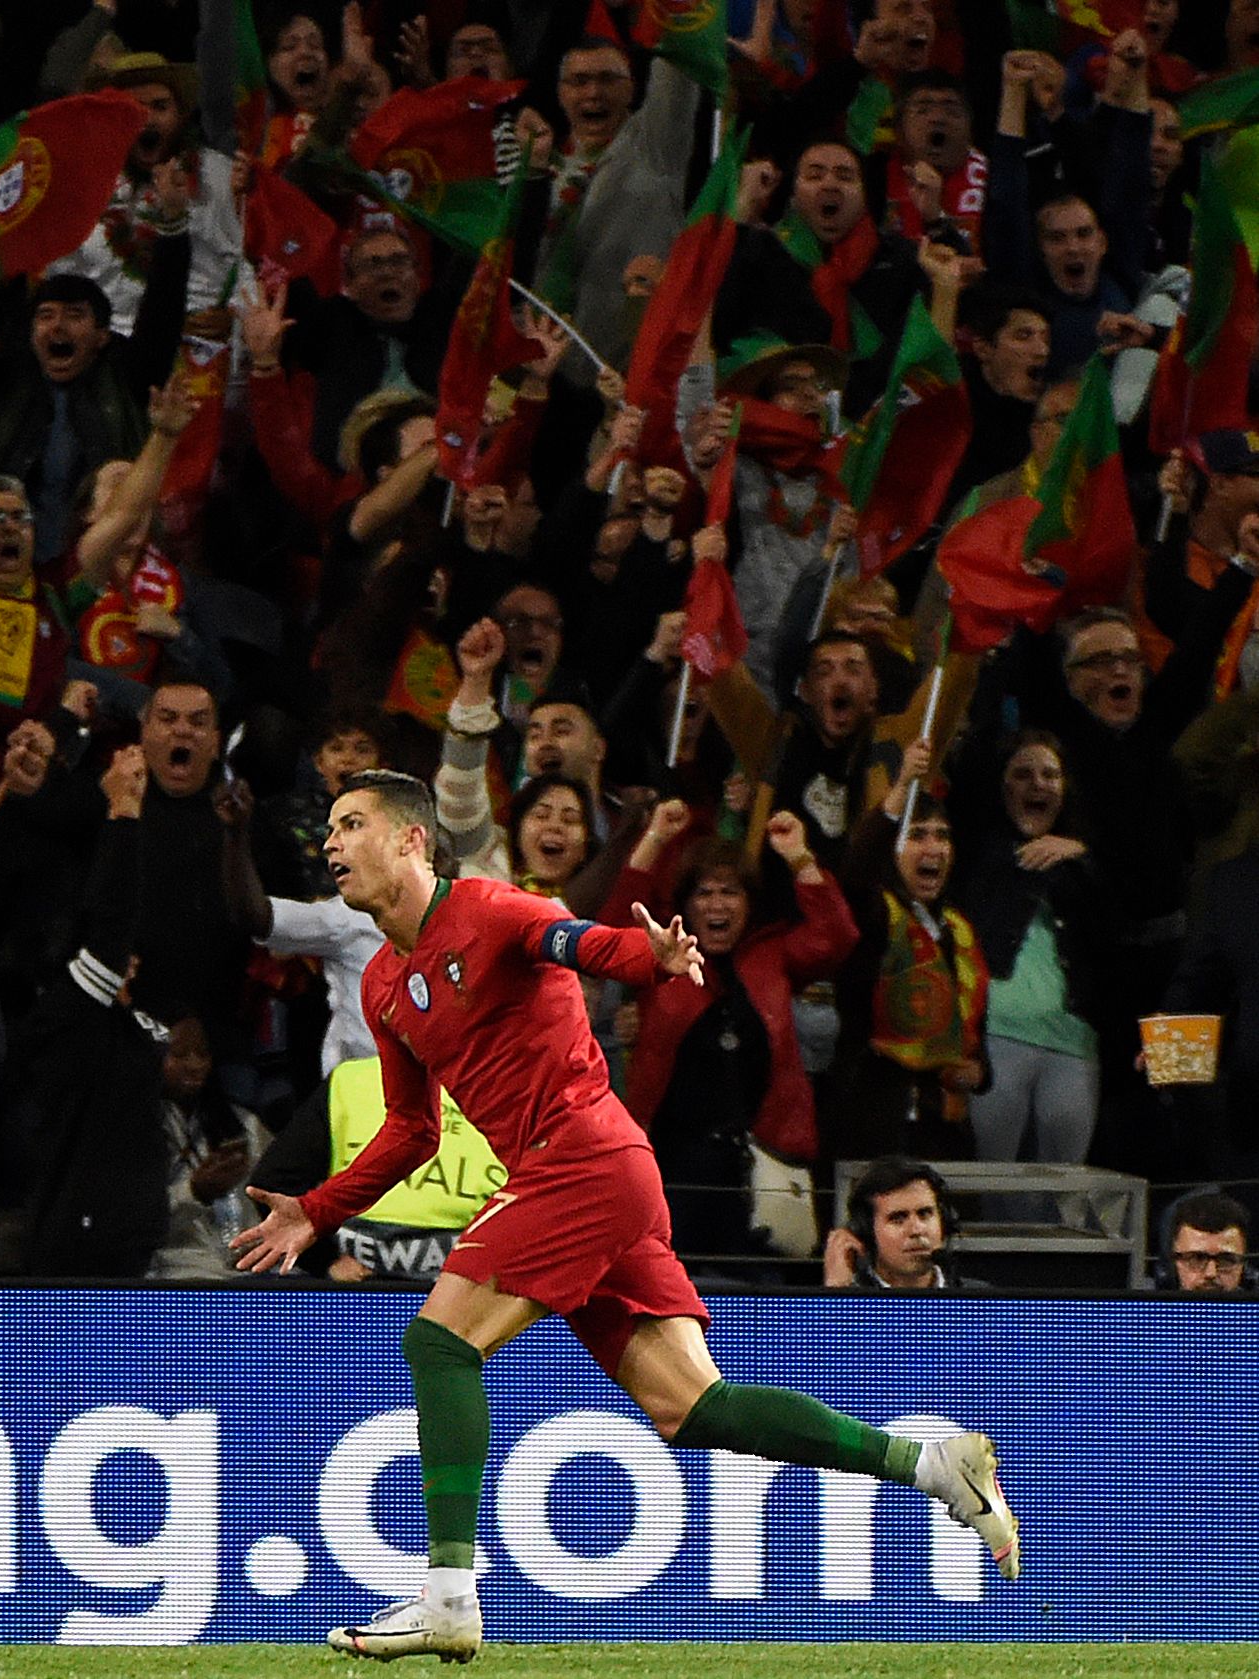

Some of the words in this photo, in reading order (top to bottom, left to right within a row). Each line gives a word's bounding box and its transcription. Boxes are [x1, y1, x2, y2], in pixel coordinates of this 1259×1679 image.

[405, 1155, 507, 1201] ALS
[467, 1191, 519, 1234] 7
[337, 1227, 460, 1272] TEWA
